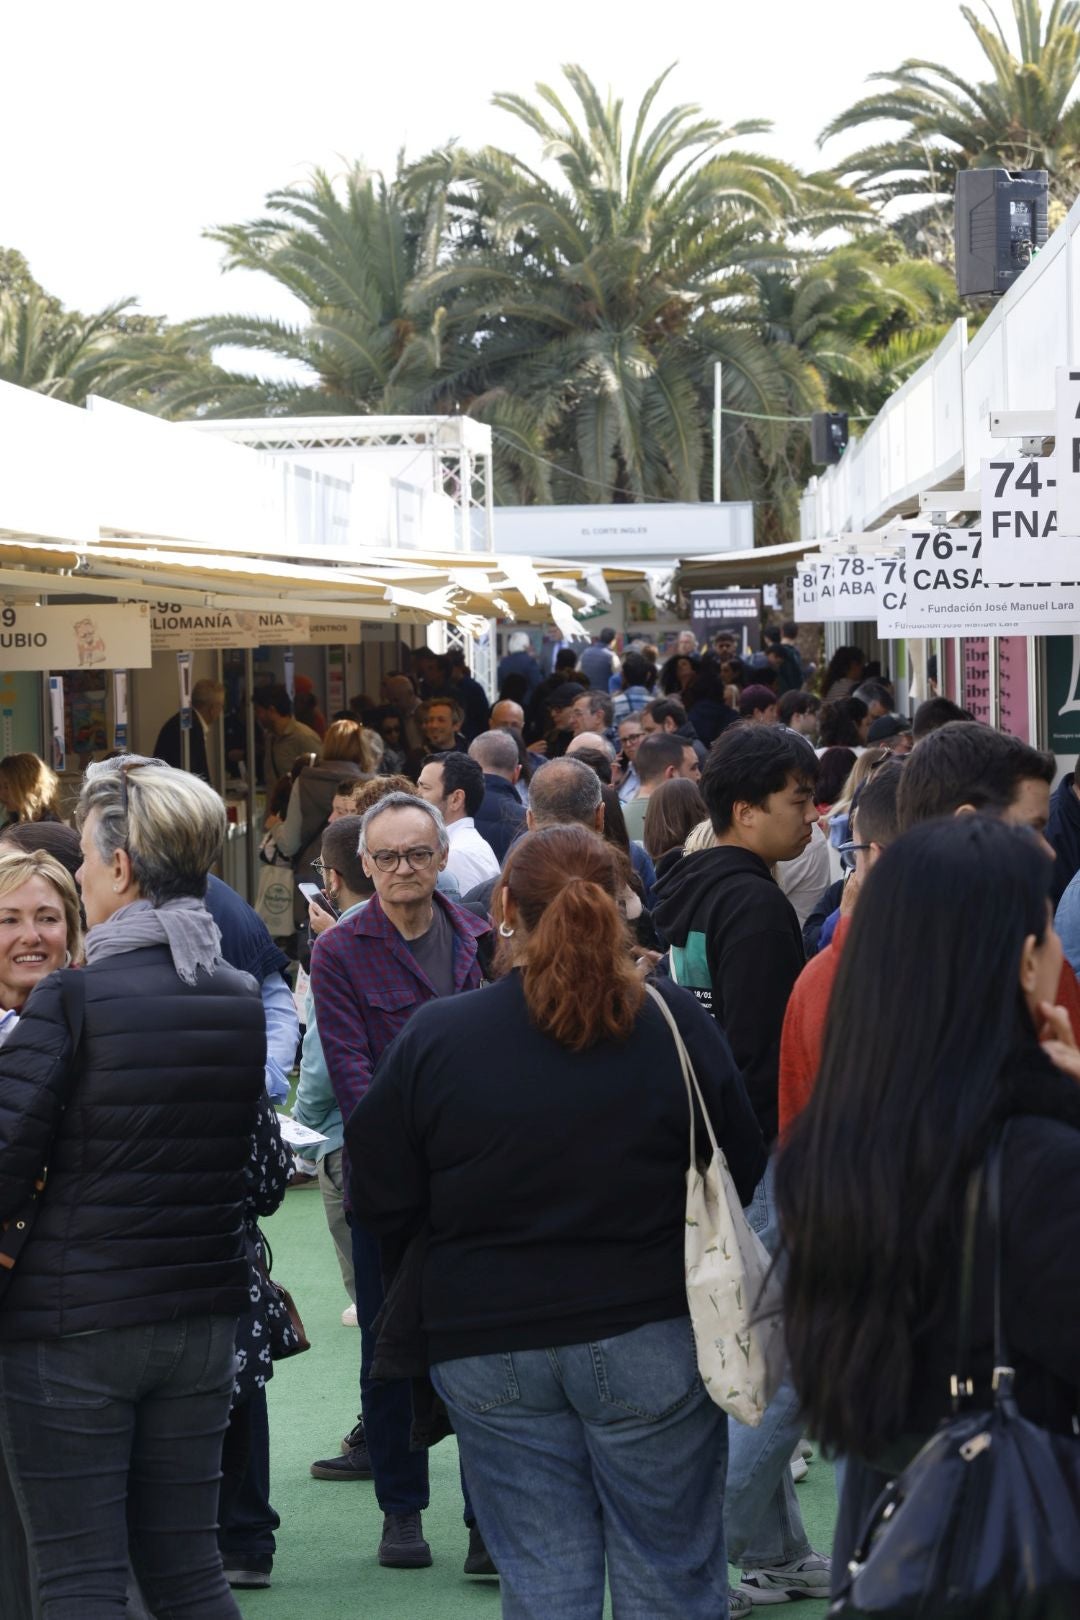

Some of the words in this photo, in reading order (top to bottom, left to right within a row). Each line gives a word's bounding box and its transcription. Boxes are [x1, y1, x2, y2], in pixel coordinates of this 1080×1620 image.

[928, 603, 981, 613] Fundación
[984, 602, 1006, 611] José
[1010, 601, 1048, 610] Manuel
[1051, 601, 1074, 609] Lara
[150, 613, 232, 630] LIOMANÍA
